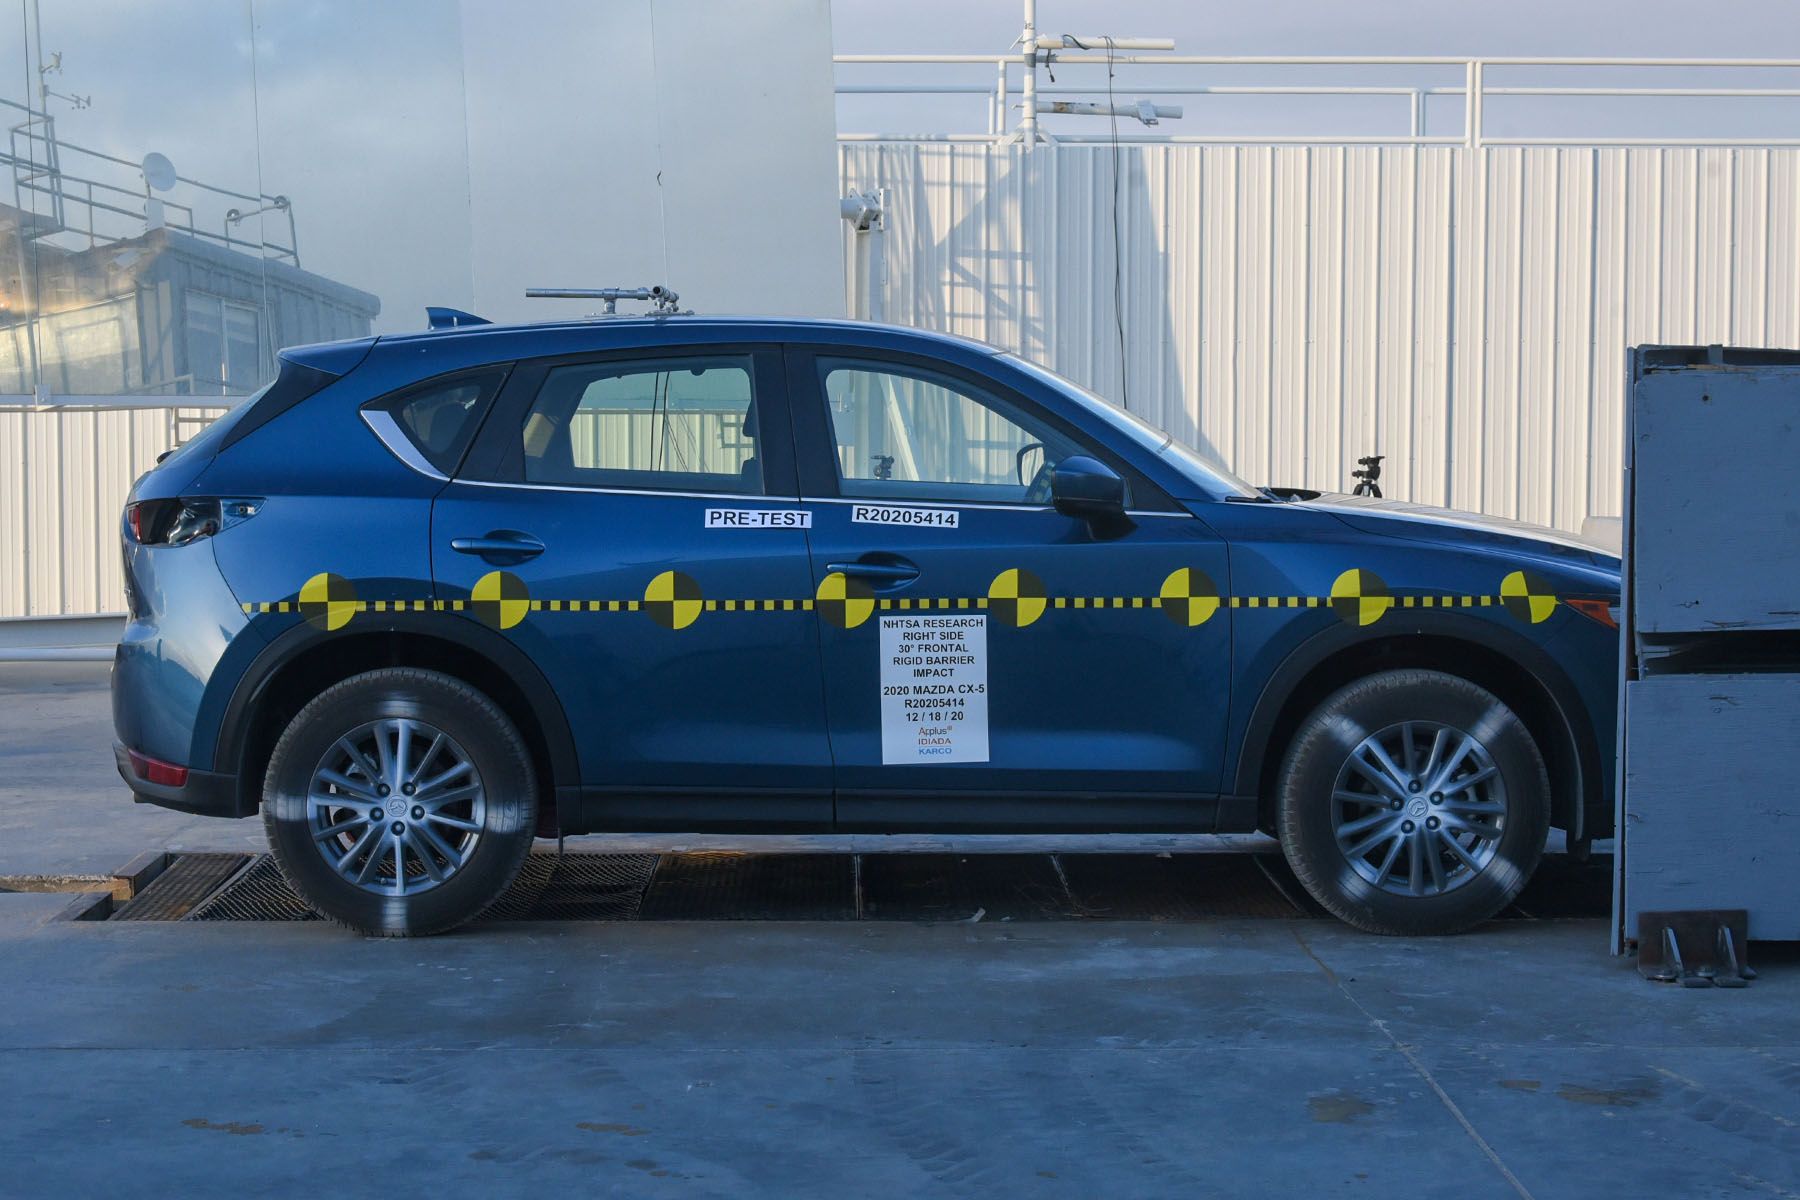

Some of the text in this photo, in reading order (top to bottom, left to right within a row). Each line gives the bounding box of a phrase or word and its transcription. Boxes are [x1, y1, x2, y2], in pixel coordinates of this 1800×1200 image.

[710, 511, 809, 526] PRE-TEST
[855, 507, 956, 526] R20205414
[883, 618, 984, 629] NHTSA RESEARCH
[903, 631, 965, 641] RIGHT SIDE
[898, 643, 969, 653] 30° FRONTAL
[893, 655, 975, 666] RIGID BARRIER
[913, 668, 955, 678] IMPACT
[883, 684, 985, 696] 2020 MAZDA CX-5
[904, 698, 965, 708] R20205414
[906, 712, 918, 722] 12
[928, 711, 941, 721] 18
[951, 711, 964, 721] 20
[918, 726, 948, 738] Applus
[918, 737, 952, 745] IDIADA
[919, 747, 952, 756] KARCO
